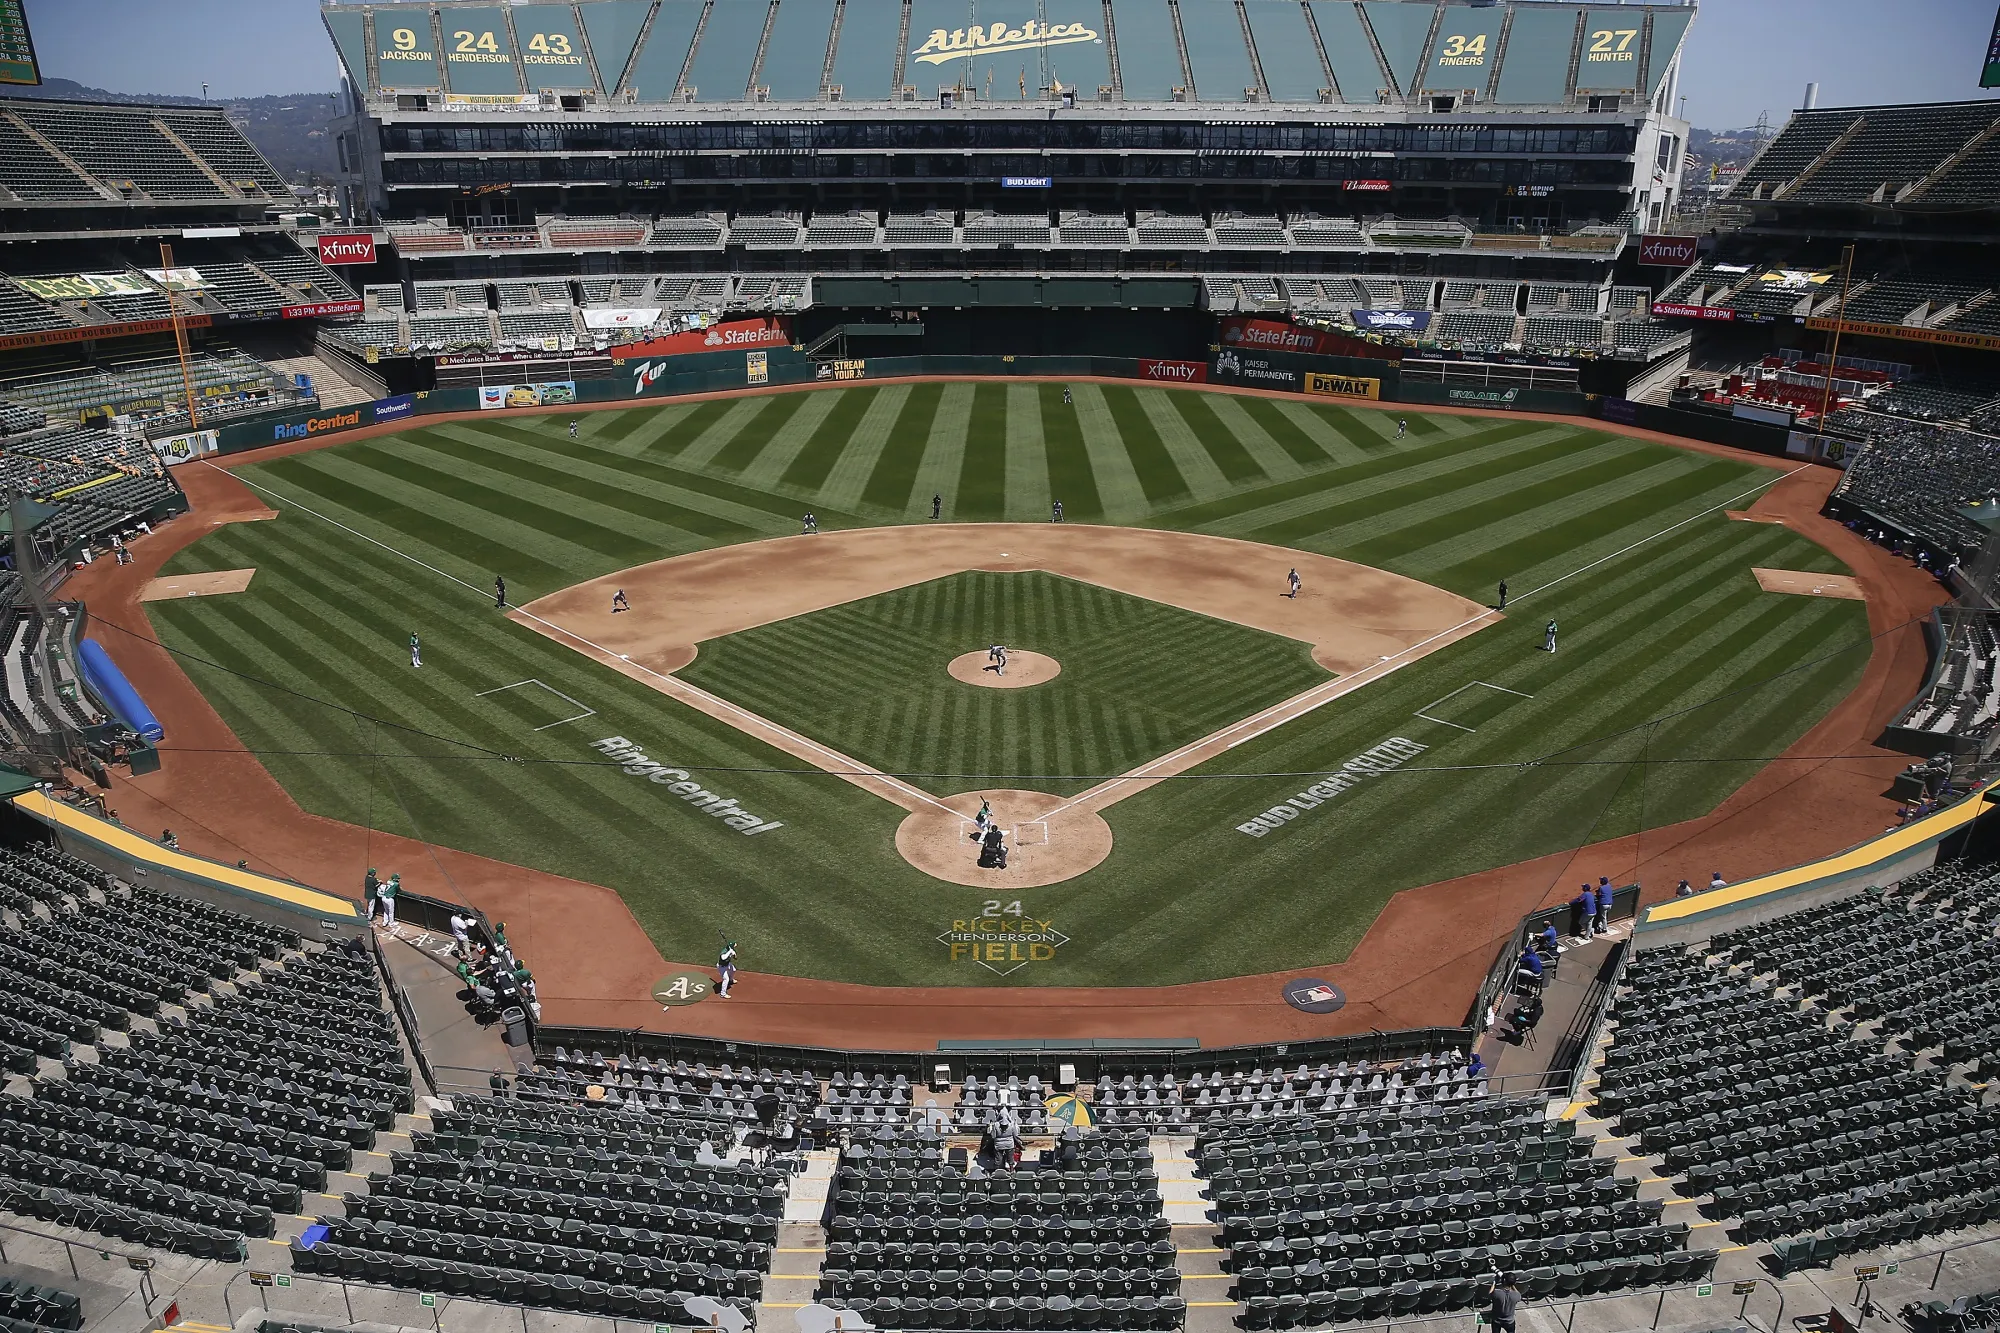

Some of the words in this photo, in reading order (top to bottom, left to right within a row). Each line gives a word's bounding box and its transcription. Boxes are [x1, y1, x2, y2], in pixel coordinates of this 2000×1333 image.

[392, 28, 416, 51] 9
[453, 30, 499, 53] 24
[528, 33, 572, 56] 43
[911, 19, 1098, 60] Athletics
[1443, 34, 1487, 56] 34
[1589, 29, 1637, 52] 27
[380, 50, 432, 61] JACKSON
[448, 54, 510, 64] HENDERSON
[524, 55, 584, 66] ECKERSLEY
[1438, 56, 1485, 66] FINGERS
[1588, 51, 1633, 62] HUNTER
[470, 96, 490, 104] VISITING
[492, 96, 501, 104] FAN
[1346, 180, 1390, 191] Budweiser
[322, 240, 372, 258] xfinity
[1643, 242, 1693, 260] xfinity
[288, 308, 302, 316] 1:33
[304, 307, 315, 316] PM
[1702, 309, 1717, 318] 1:33
[1718, 310, 1730, 318] PM
[40, 333, 78, 342] BULLEIT
[81, 327, 124, 338] BOURBON
[128, 322, 164, 332] BULLEIT
[168, 318, 208, 329] BRBON
[1810, 320, 1845, 331] BULLEIT
[1848, 324, 1892, 334] BOURBON
[1895, 330, 1932, 340] BULLEIT
[1934, 334, 1980, 346] BOURBON
[450, 356, 484, 365] Mechanics
[534, 349, 574, 358] Relationships
[574, 349, 594, 357] Matter
[1244, 360, 1269, 368] KAISER
[834, 360, 864, 370] STREAM
[1148, 362, 1196, 380] xfinity
[834, 370, 854, 380] YOUR
[416, 390, 429, 400] 367
[1450, 390, 1475, 400] EVA
[1476, 392, 1500, 400] AIR
[120, 401, 145, 414] GOLDEN
[146, 400, 162, 408] ROAD
[376, 402, 406, 414] Southwest
[274, 410, 360, 440] RingCentral
[172, 438, 188, 453] 811
[1829, 441, 1845, 454] 811
[588, 736, 784, 836] RingCentral
[1235, 806, 1300, 838] BUD
[1286, 770, 1362, 811] LIGHT
[1342, 736, 1430, 778] SELTZER
[982, 900, 1023, 917] 24
[952, 920, 1052, 932] RICKEY
[376, 926, 408, 940] A's
[406, 932, 436, 947] A's
[950, 934, 1055, 942] HENDERSON
[950, 942, 1056, 961] FIELD
[656, 976, 706, 1000] A's
